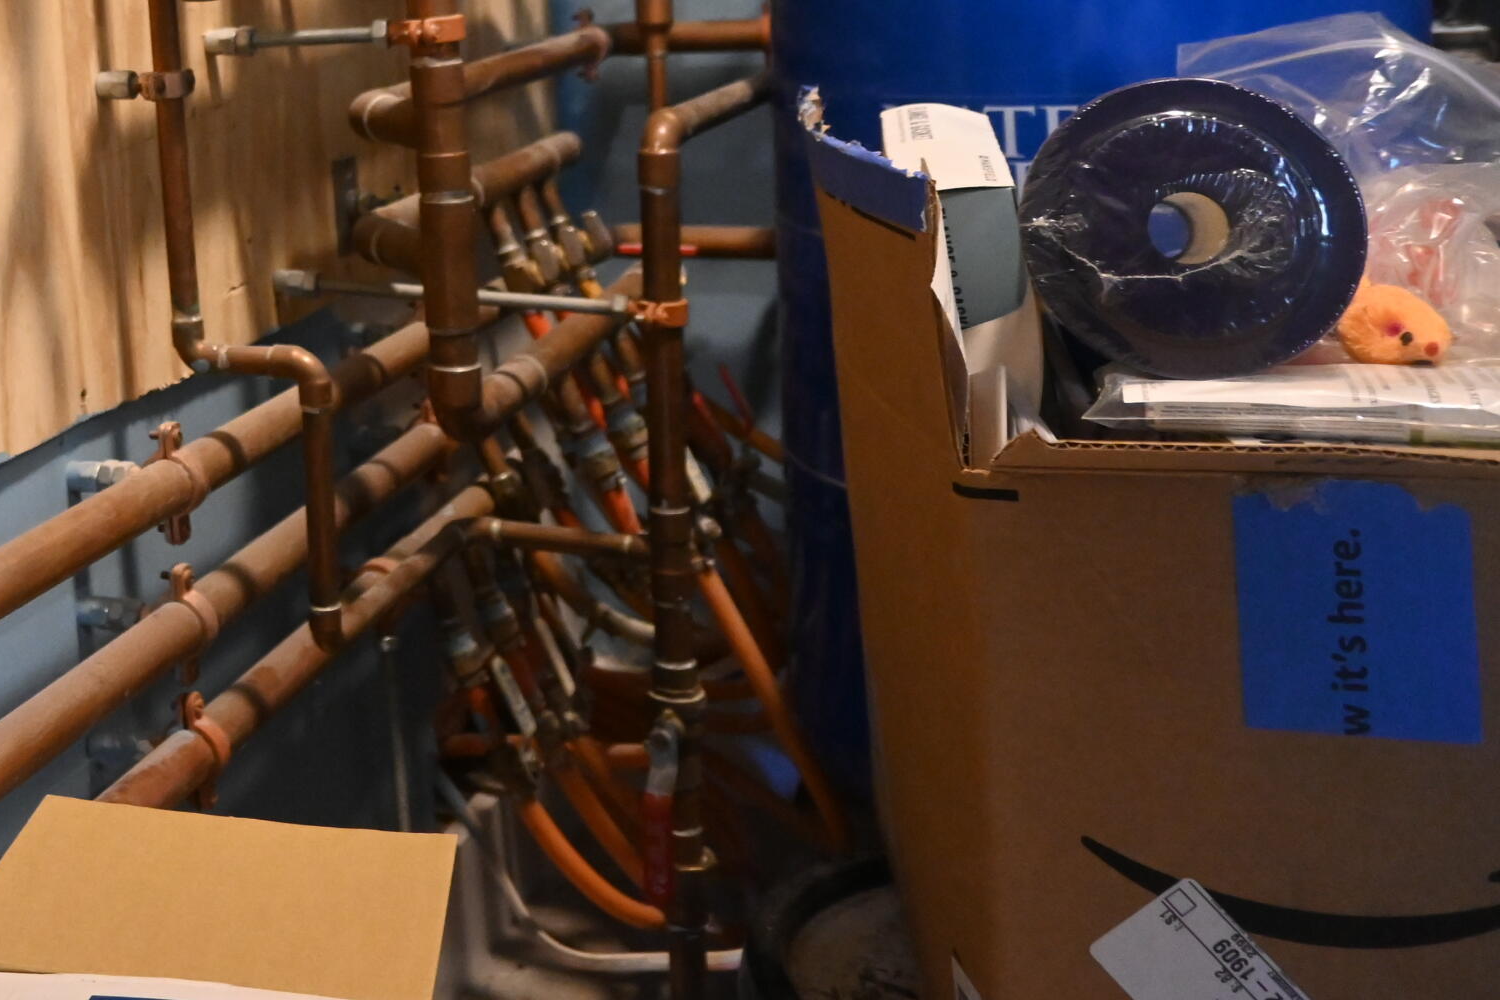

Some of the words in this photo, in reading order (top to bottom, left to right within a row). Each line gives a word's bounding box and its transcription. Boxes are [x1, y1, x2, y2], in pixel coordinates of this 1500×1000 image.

[1326, 528, 1365, 625] here.
[1331, 636, 1369, 692] it's
[1212, 938, 1256, 982] 1909
